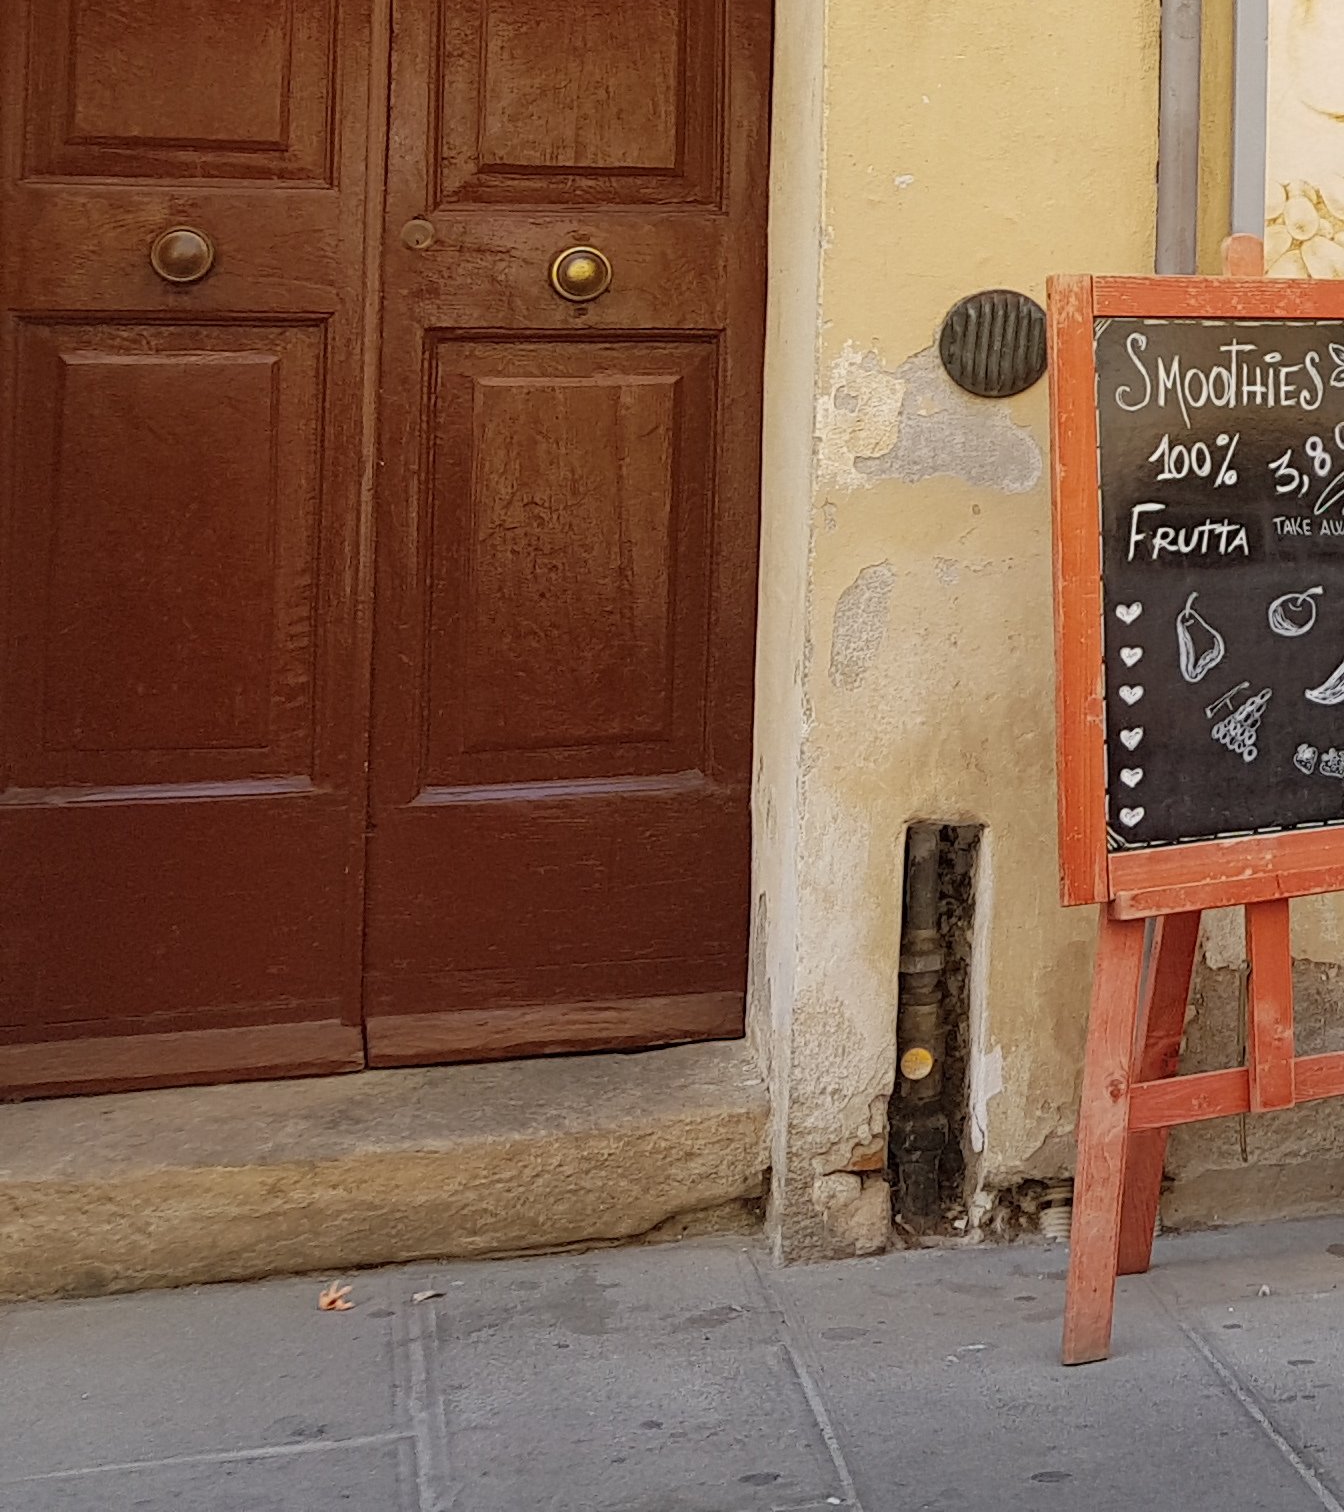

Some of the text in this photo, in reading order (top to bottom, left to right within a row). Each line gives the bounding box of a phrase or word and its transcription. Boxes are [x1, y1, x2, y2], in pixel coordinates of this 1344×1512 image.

[1148, 432, 1240, 489] 100%
[1126, 503, 1249, 562] FRUTTA
[1273, 516, 1313, 537] TAKE
